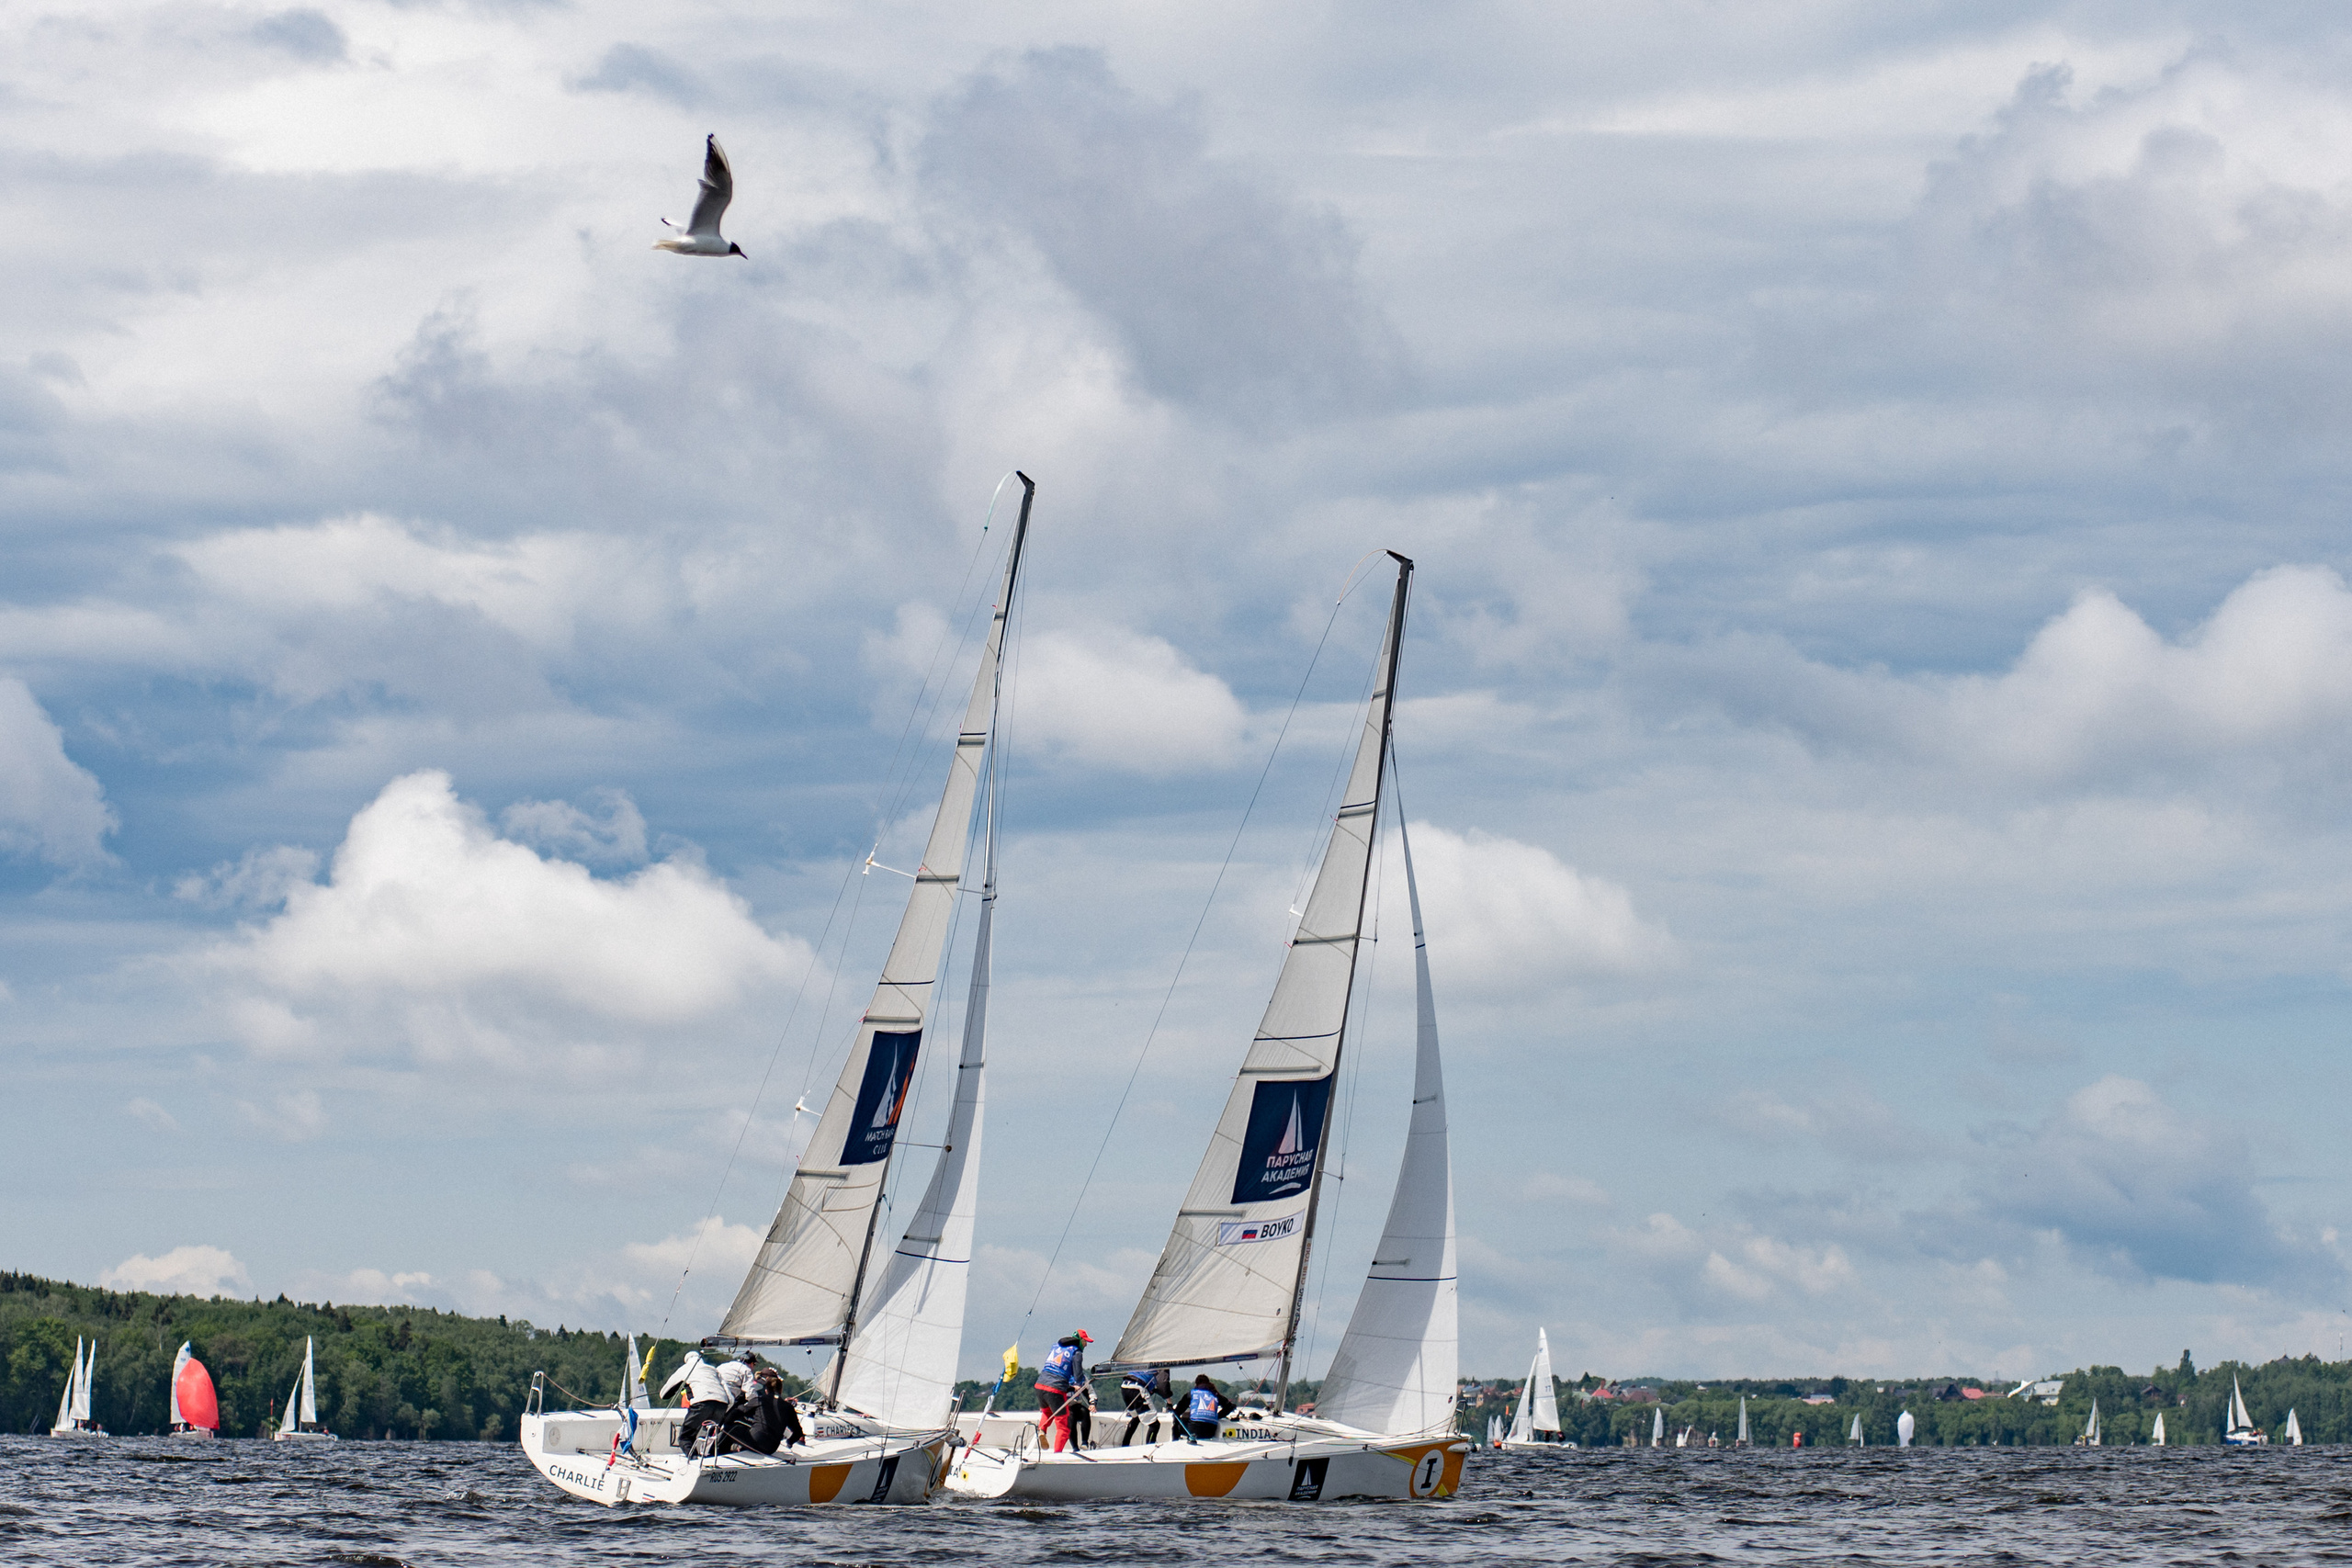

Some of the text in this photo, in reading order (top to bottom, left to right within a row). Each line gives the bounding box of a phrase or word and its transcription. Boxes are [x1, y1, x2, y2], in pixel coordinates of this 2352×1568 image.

[1266, 1148, 1314, 1168] ПАРУСНАЯ
[1261, 1163, 1310, 1183] АКАДЕМИЯ
[1260, 1218, 1294, 1238] BOYKO
[1236, 1428, 1272, 1439] INDIA
[549, 1464, 605, 1492] CHARLIE
[709, 1472, 723, 1483] RUS
